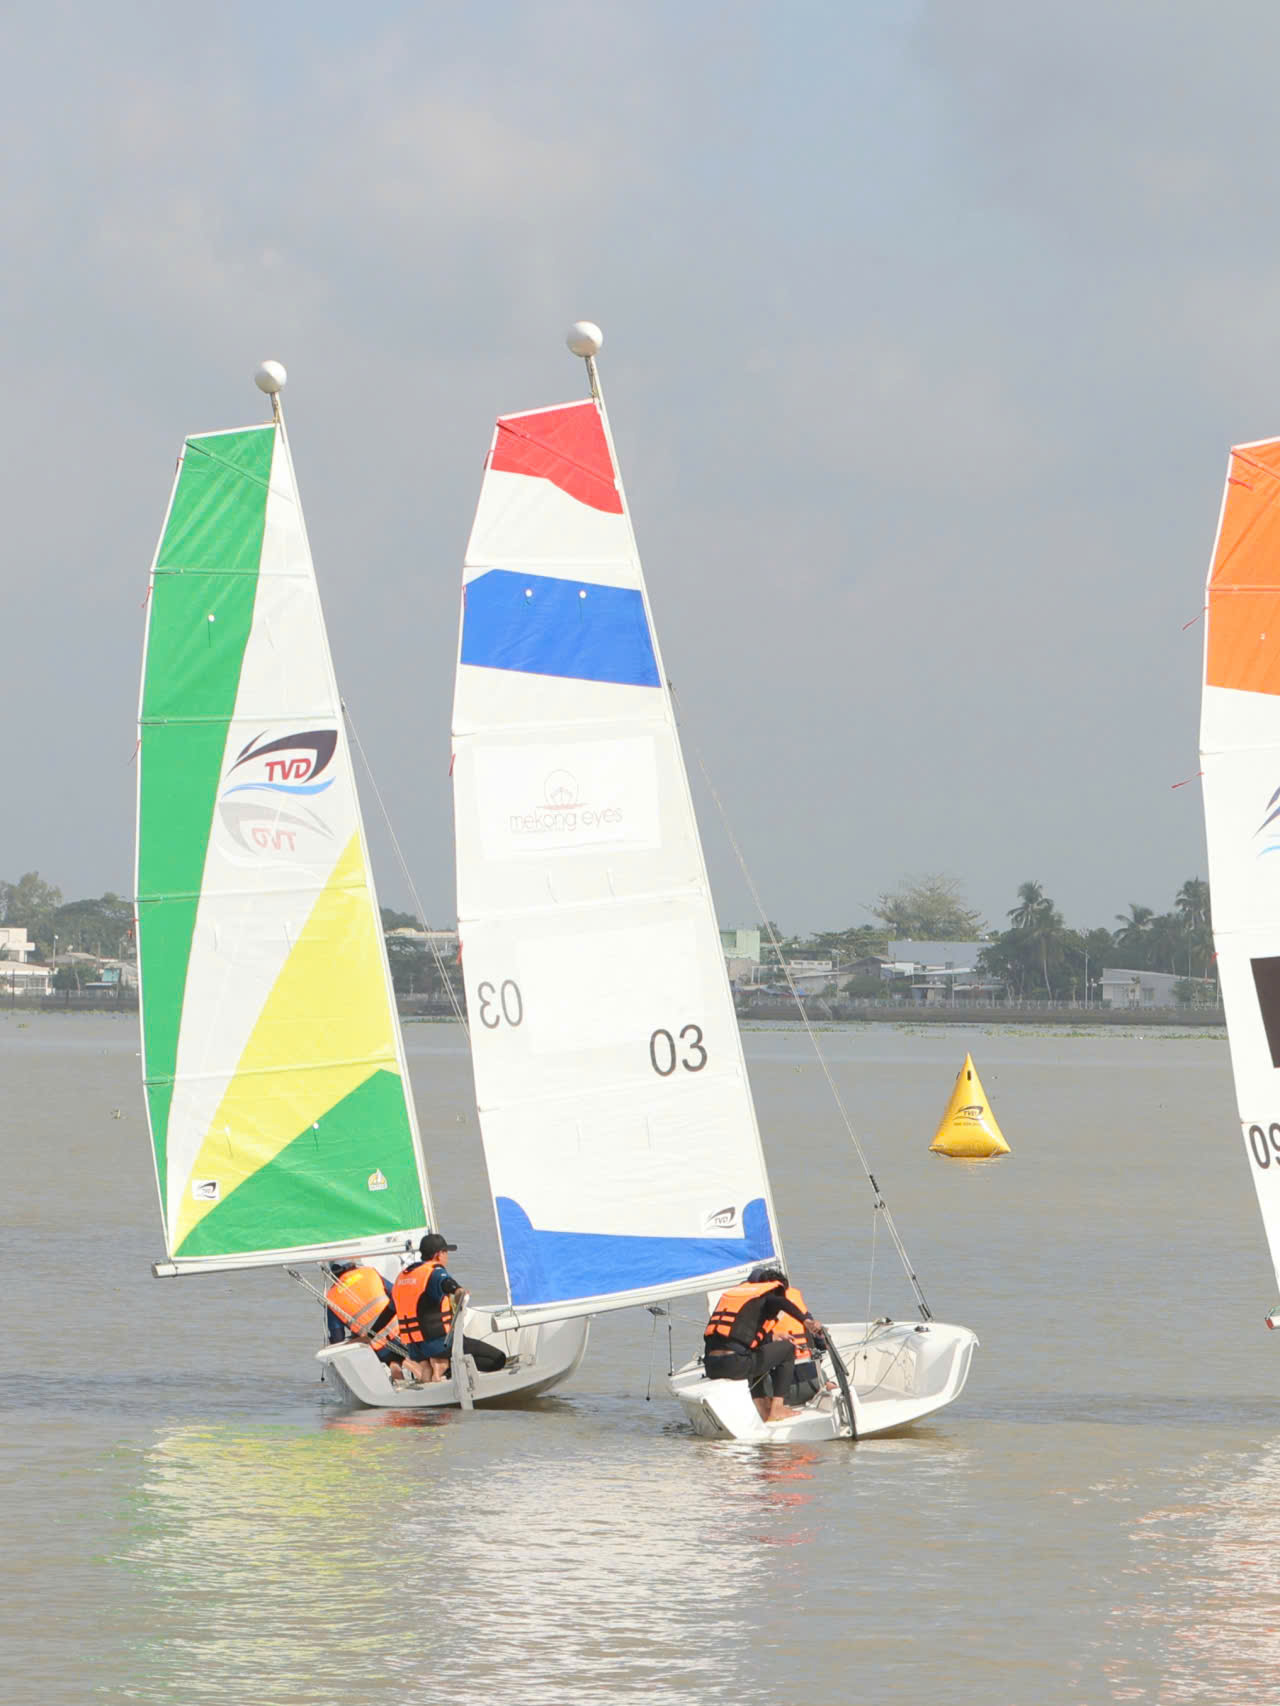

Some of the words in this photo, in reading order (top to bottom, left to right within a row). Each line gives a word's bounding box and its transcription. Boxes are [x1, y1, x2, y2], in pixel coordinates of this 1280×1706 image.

[264, 758, 312, 782] TVD
[509, 808, 577, 832] mekong
[581, 807, 623, 830] eyes
[649, 1024, 708, 1077] 03
